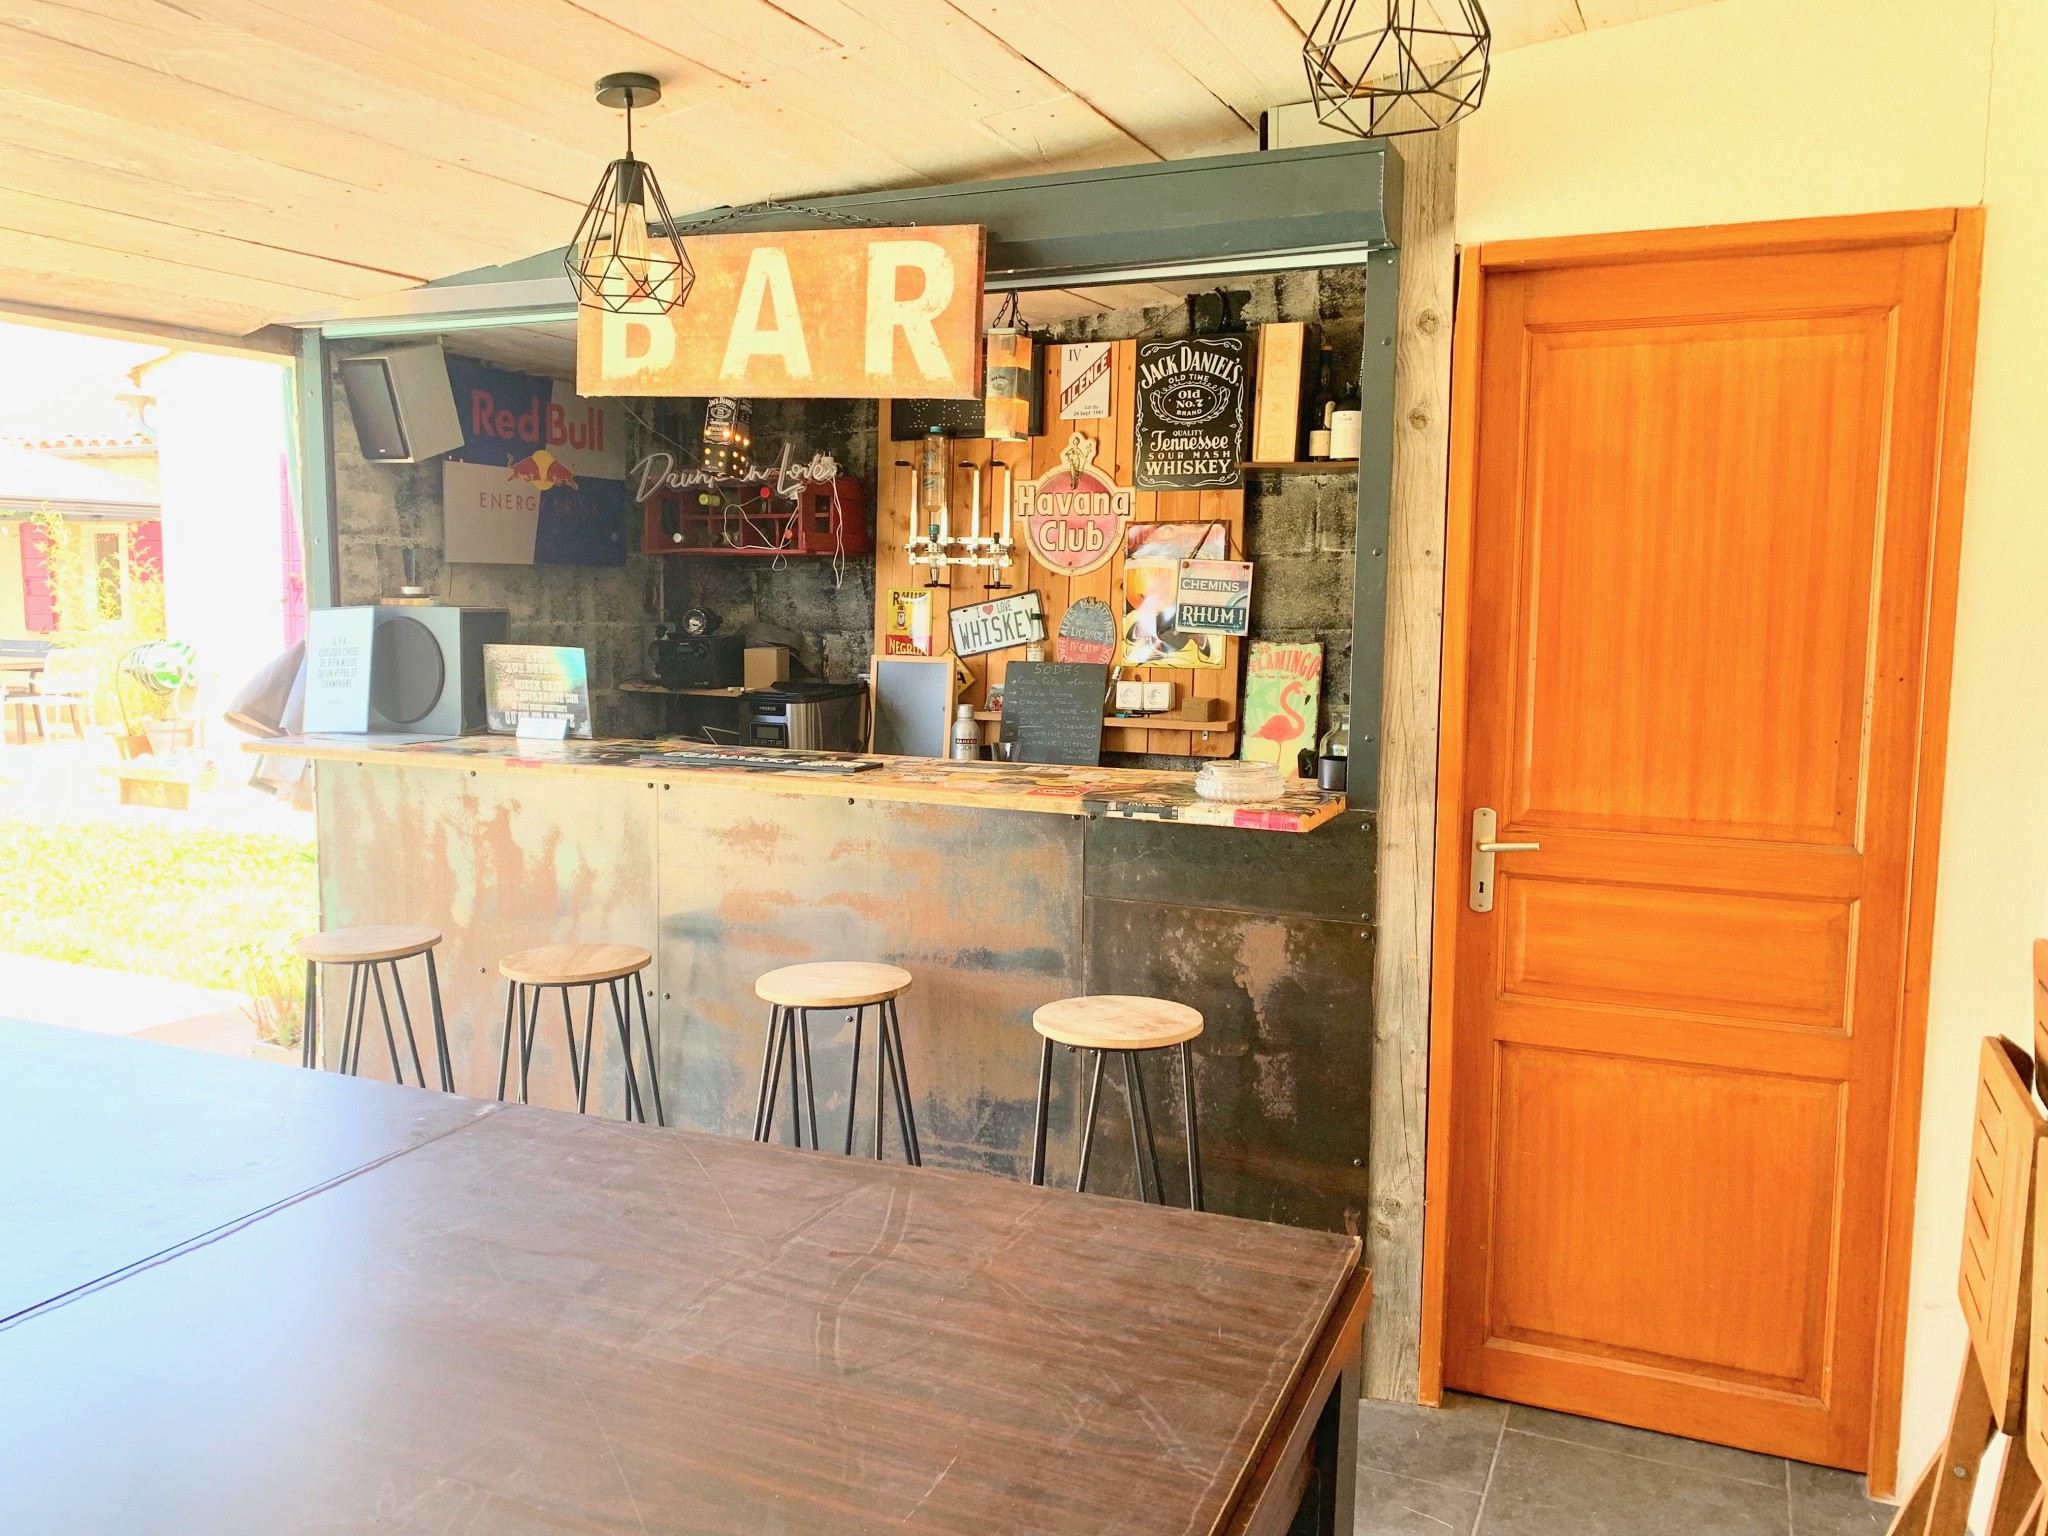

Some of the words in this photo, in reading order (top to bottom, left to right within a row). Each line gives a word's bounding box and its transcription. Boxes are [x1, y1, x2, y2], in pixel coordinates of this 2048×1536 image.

[601, 240, 955, 383] BAR
[1069, 349, 1081, 361] IV
[1140, 353, 1179, 389] JACK
[1180, 345, 1243, 385] DANIEL'S
[1061, 350, 1109, 412] LICENCE
[1168, 374, 1186, 384] OLD
[1188, 373, 1210, 382] TIME
[1178, 389, 1201, 399] Old
[1175, 399, 1204, 409] No.7
[472, 388, 540, 443] Red
[546, 403, 605, 452] Bull
[1150, 430, 1229, 452] Tennessee
[1172, 429, 1204, 437] QUALITY
[1148, 451, 1184, 460] SOUR
[1192, 450, 1231, 459] MASH
[776, 442, 837, 495] Love
[1145, 459, 1232, 475] WHISKEY
[1018, 485, 1131, 517] Havana
[1039, 520, 1104, 552] Club
[1181, 579, 1240, 592] CHEMINS
[997, 600, 1013, 614] LOVE
[958, 607, 1034, 651] WHISKEY
[1060, 608, 1077, 637] ALPES
[1071, 626, 1104, 641] LICENCE
[1034, 663, 1081, 676] SODAS
[1250, 650, 1322, 682] FLAMINGO
[1017, 675, 1037, 685] Coca
[1042, 676, 1060, 686] Cola
